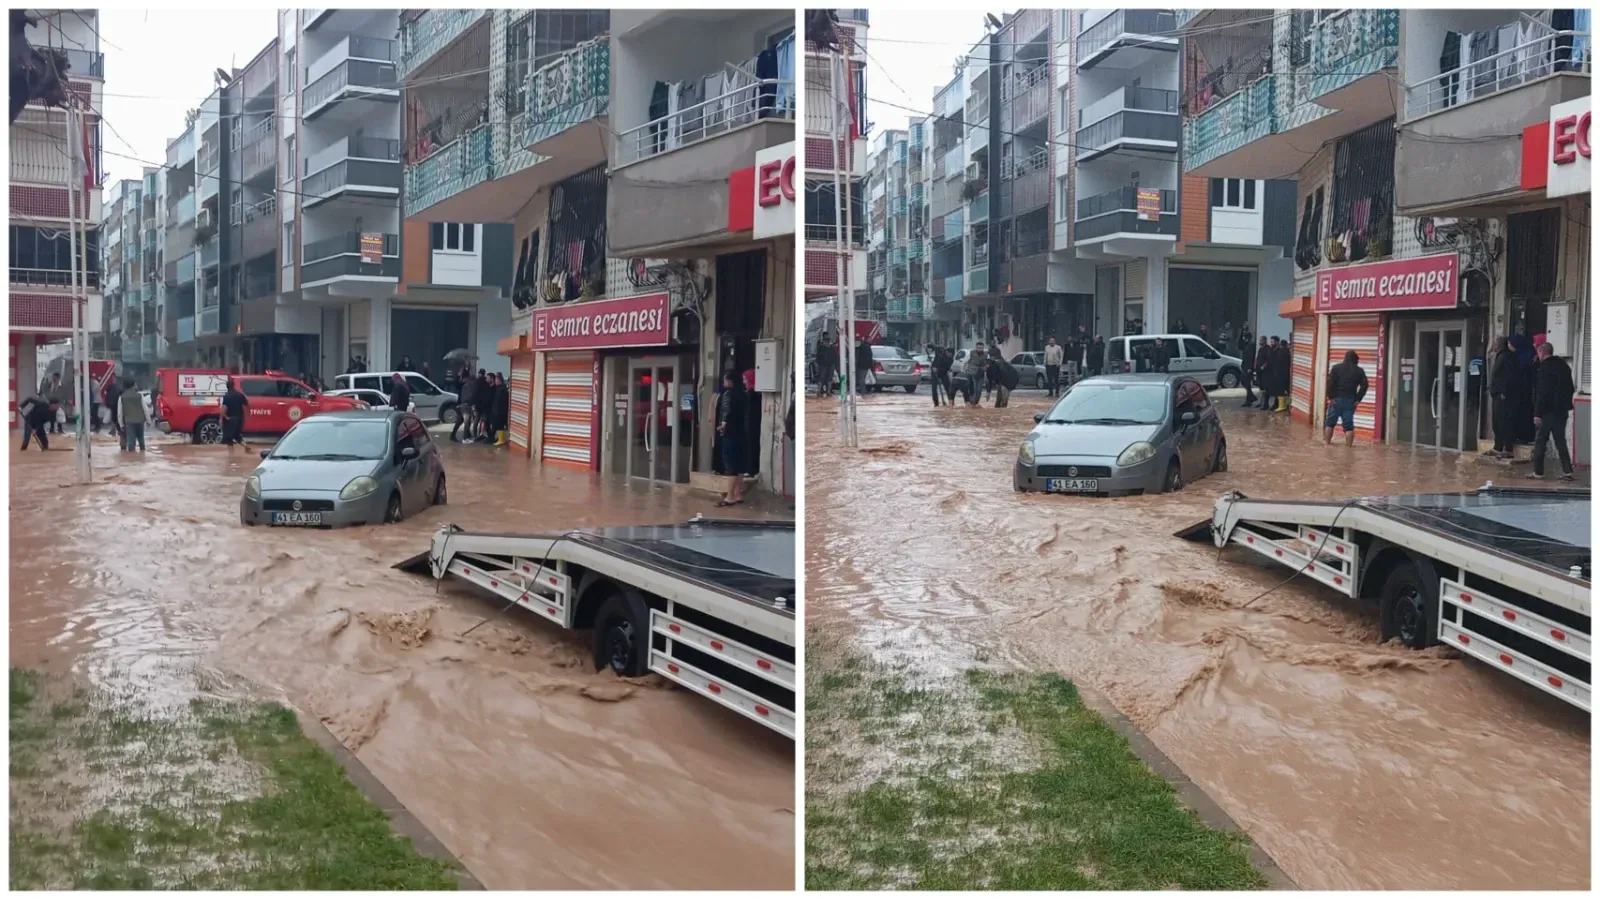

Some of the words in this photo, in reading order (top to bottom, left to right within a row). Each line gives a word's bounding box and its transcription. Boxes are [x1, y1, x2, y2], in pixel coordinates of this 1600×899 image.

[1321, 280, 1329, 301] E
[1335, 276, 1377, 301] semra
[1379, 259, 1453, 297] eczanesi
[537, 318, 545, 341] E
[550, 315, 590, 338] semra
[593, 298, 664, 335] eczanesi
[184, 376, 194, 384] 112
[1053, 480, 1062, 489] 41
[1065, 480, 1078, 489] EA
[1081, 480, 1096, 489] 160
[277, 513, 287, 522] 41
[289, 513, 303, 522] EA
[305, 513, 320, 522] 160
